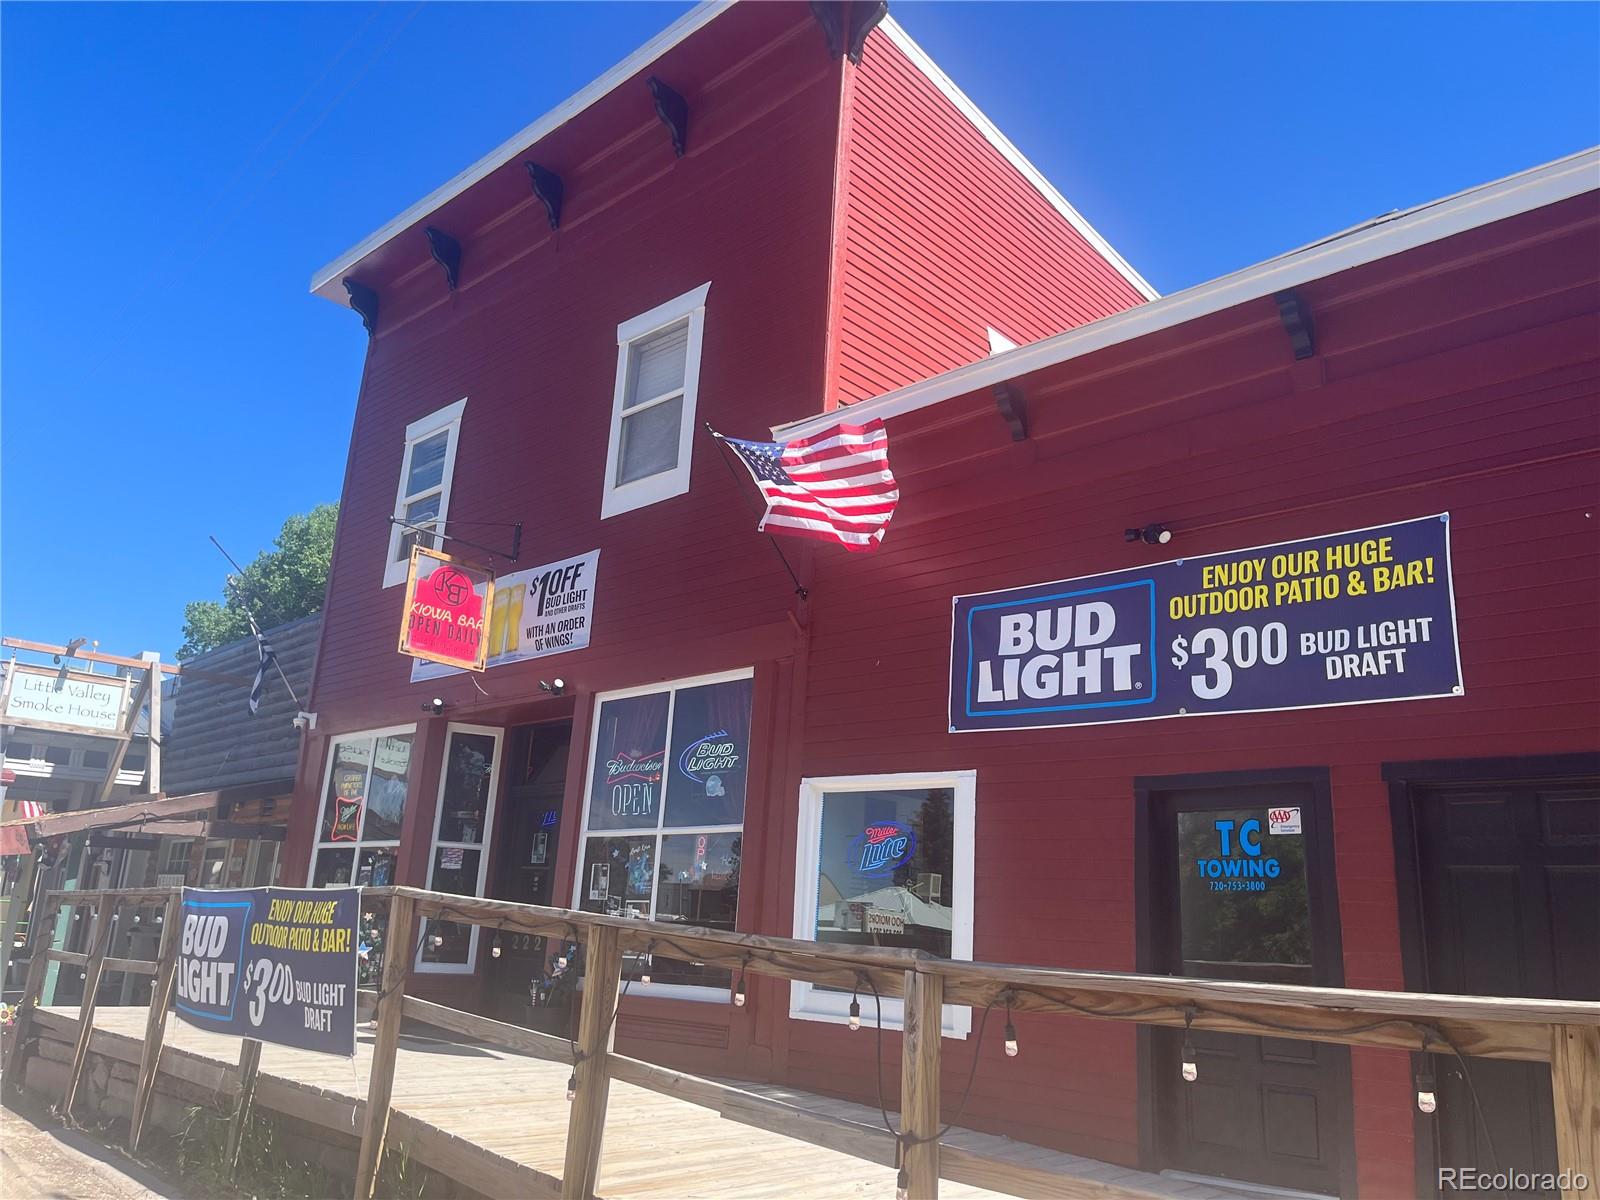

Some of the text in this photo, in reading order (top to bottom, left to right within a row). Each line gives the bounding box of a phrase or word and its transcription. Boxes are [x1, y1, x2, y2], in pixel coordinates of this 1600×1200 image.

[1202, 537, 1394, 589] ENJOY OUR HUGE
[548, 562, 585, 596] OFF
[1169, 557, 1434, 620] OUTDOOR PATIO & BAR!
[410, 601, 452, 622] KIOWA
[544, 603, 586, 617] AND OTHER DRAFTS
[545, 588, 588, 609] BUD LIGHT
[408, 614, 441, 636] OPEN
[447, 624, 482, 645] DAILY
[526, 616, 585, 640] WITH AN ORDER
[998, 601, 1116, 656] BUD
[1300, 630, 1351, 656] BUD
[1356, 617, 1433, 648] LIGHT
[535, 632, 574, 652] OF WINGS!
[977, 644, 1142, 702] LIGHT
[1324, 649, 1408, 681] DRAFT
[24, 678, 111, 707] Little Valley
[10, 696, 116, 720] Smoke House
[697, 742, 735, 757] BUD
[606, 759, 663, 776] Budweiser
[687, 755, 739, 772] LIGHT
[611, 782, 655, 816] OPEN
[1271, 810, 1289, 823] AAA
[865, 827, 899, 844] Miller
[859, 836, 908, 871] Lite
[1197, 858, 1281, 878] TOWING
[268, 899, 338, 925] ENJOY OUR HUGE
[181, 914, 229, 958] BUD
[251, 922, 351, 953] OUTDOOR PATIO & BAR!
[177, 956, 235, 1007] LIGHT
[295, 980, 312, 1003] BUD
[313, 983, 346, 1007] LIGHT
[304, 1006, 333, 1032] DRAFT
